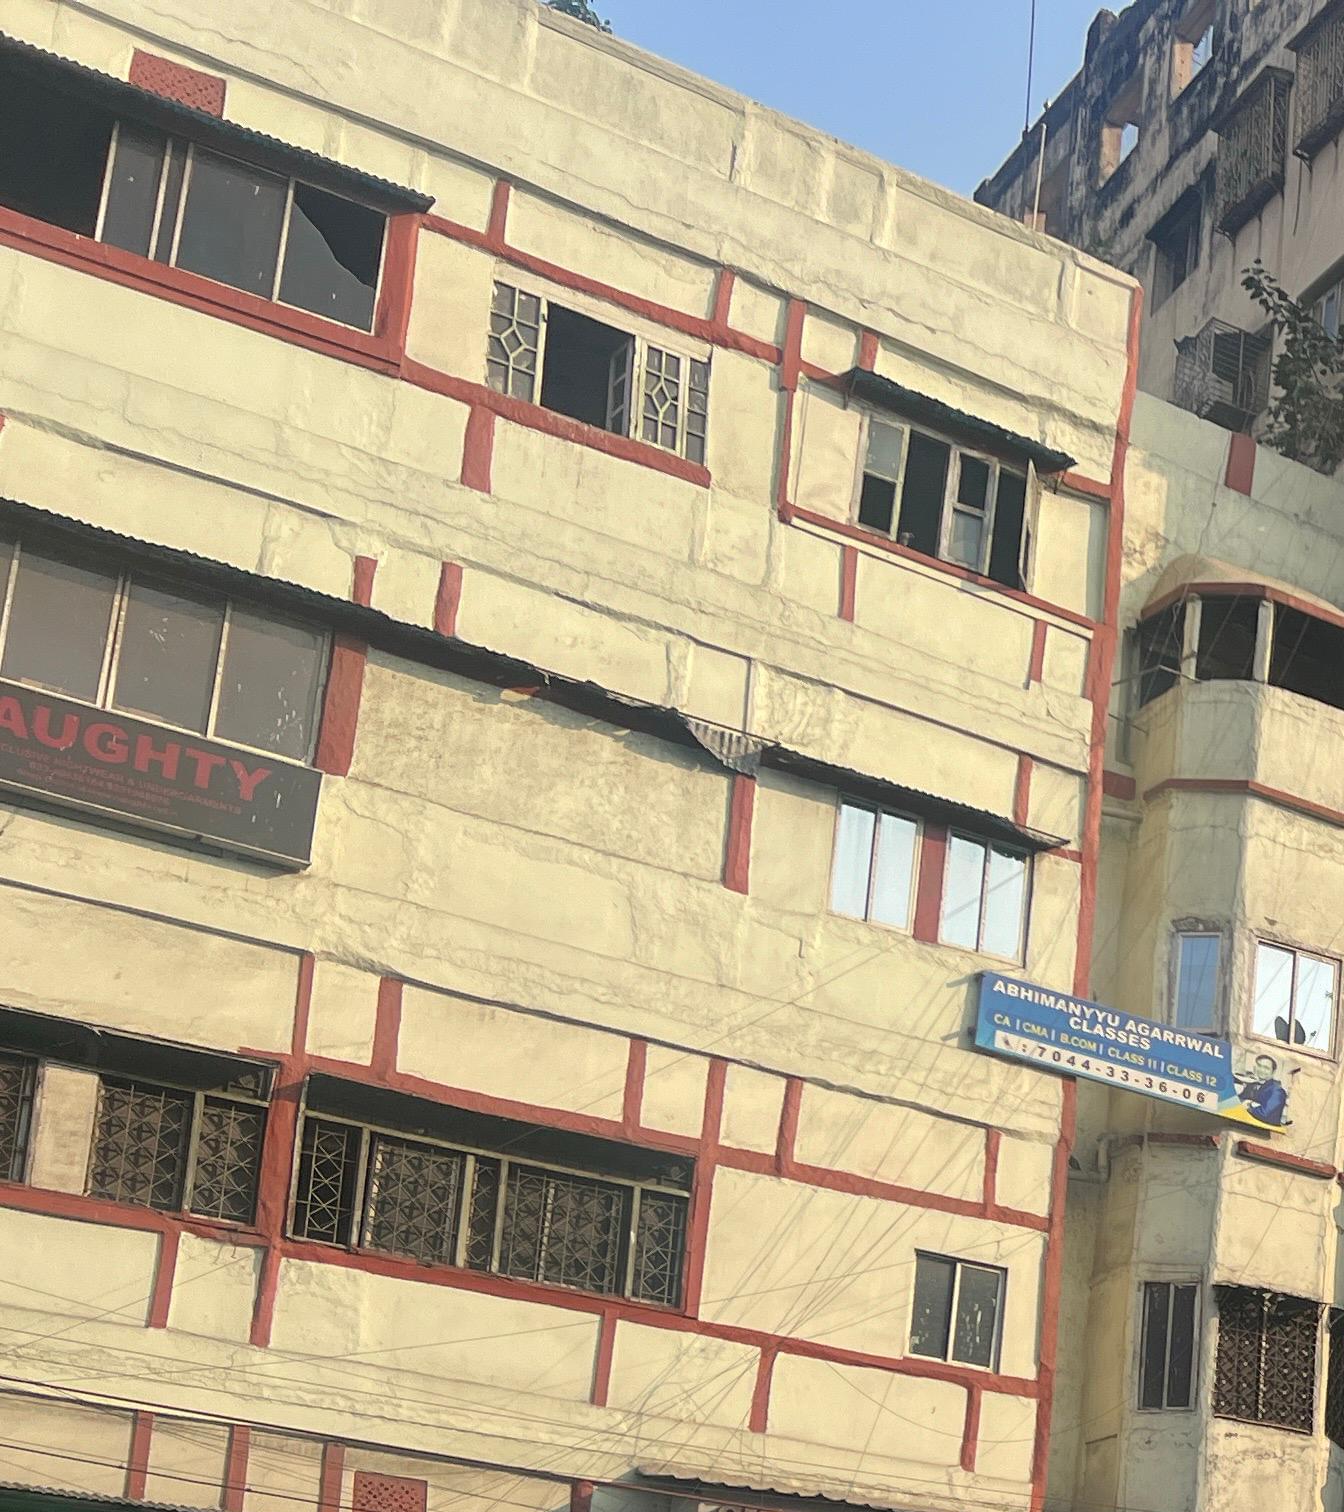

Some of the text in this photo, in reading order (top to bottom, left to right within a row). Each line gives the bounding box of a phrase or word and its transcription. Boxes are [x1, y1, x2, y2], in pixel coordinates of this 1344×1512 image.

[993, 980, 1224, 1058] ABHIMANYYU AGARRWAL
[993, 1013, 1011, 1027] CA
[1022, 1021, 1049, 1038] CMA
[1107, 1045, 1144, 1066] CLASS
[1166, 1062, 1203, 1083] CLASS
[1068, 1016, 1151, 1050] CLASSES
